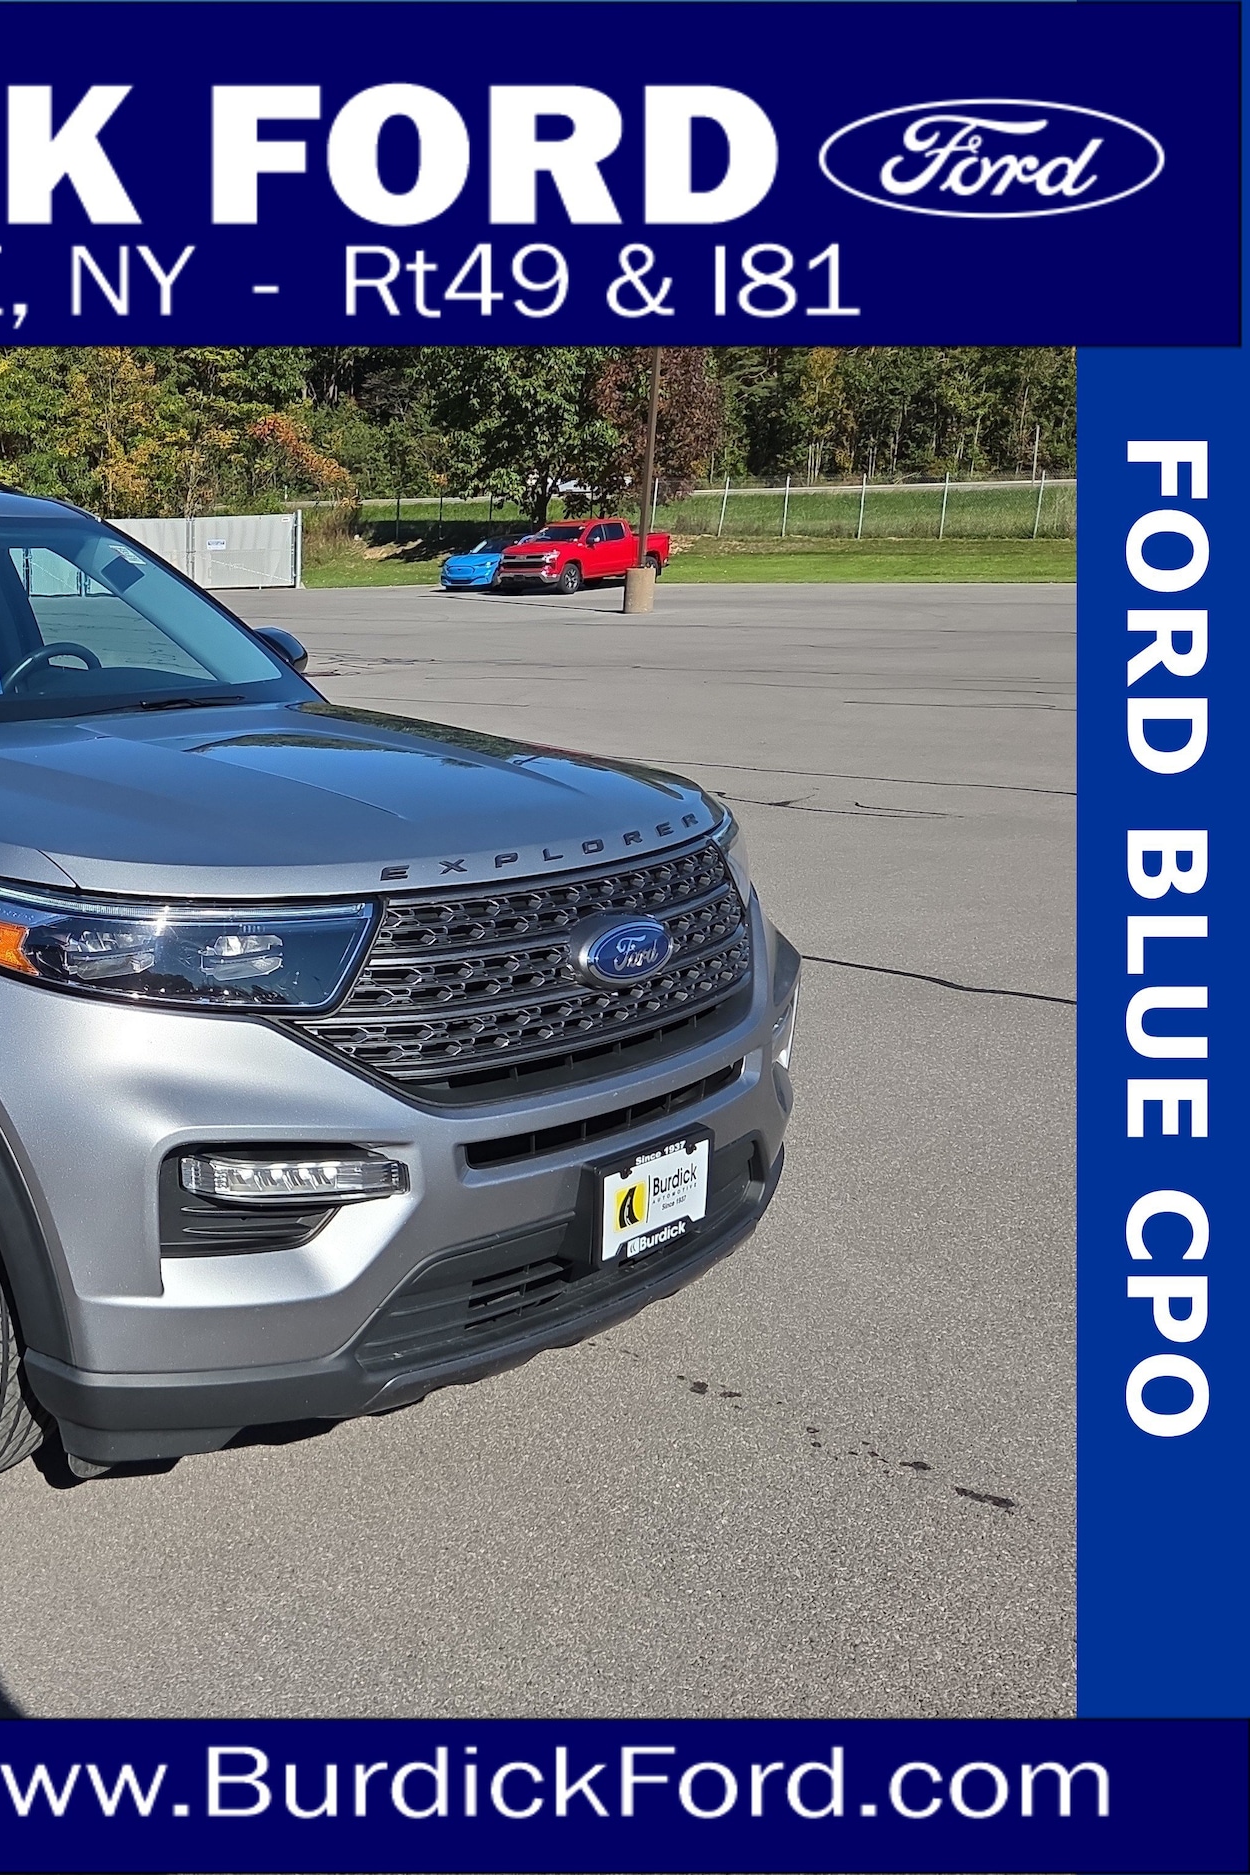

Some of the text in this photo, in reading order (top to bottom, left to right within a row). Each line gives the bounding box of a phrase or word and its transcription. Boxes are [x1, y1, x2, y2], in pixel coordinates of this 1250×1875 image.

[380, 812, 699, 881] EXPLORER
[613, 934, 659, 971] Ford
[635, 1140, 686, 1166] Since 1937
[652, 1184, 697, 1205] AUTOMOTIVE
[653, 1163, 697, 1197] Burdick
[661, 1201, 675, 1211] Since
[639, 1221, 686, 1251] Burdick
